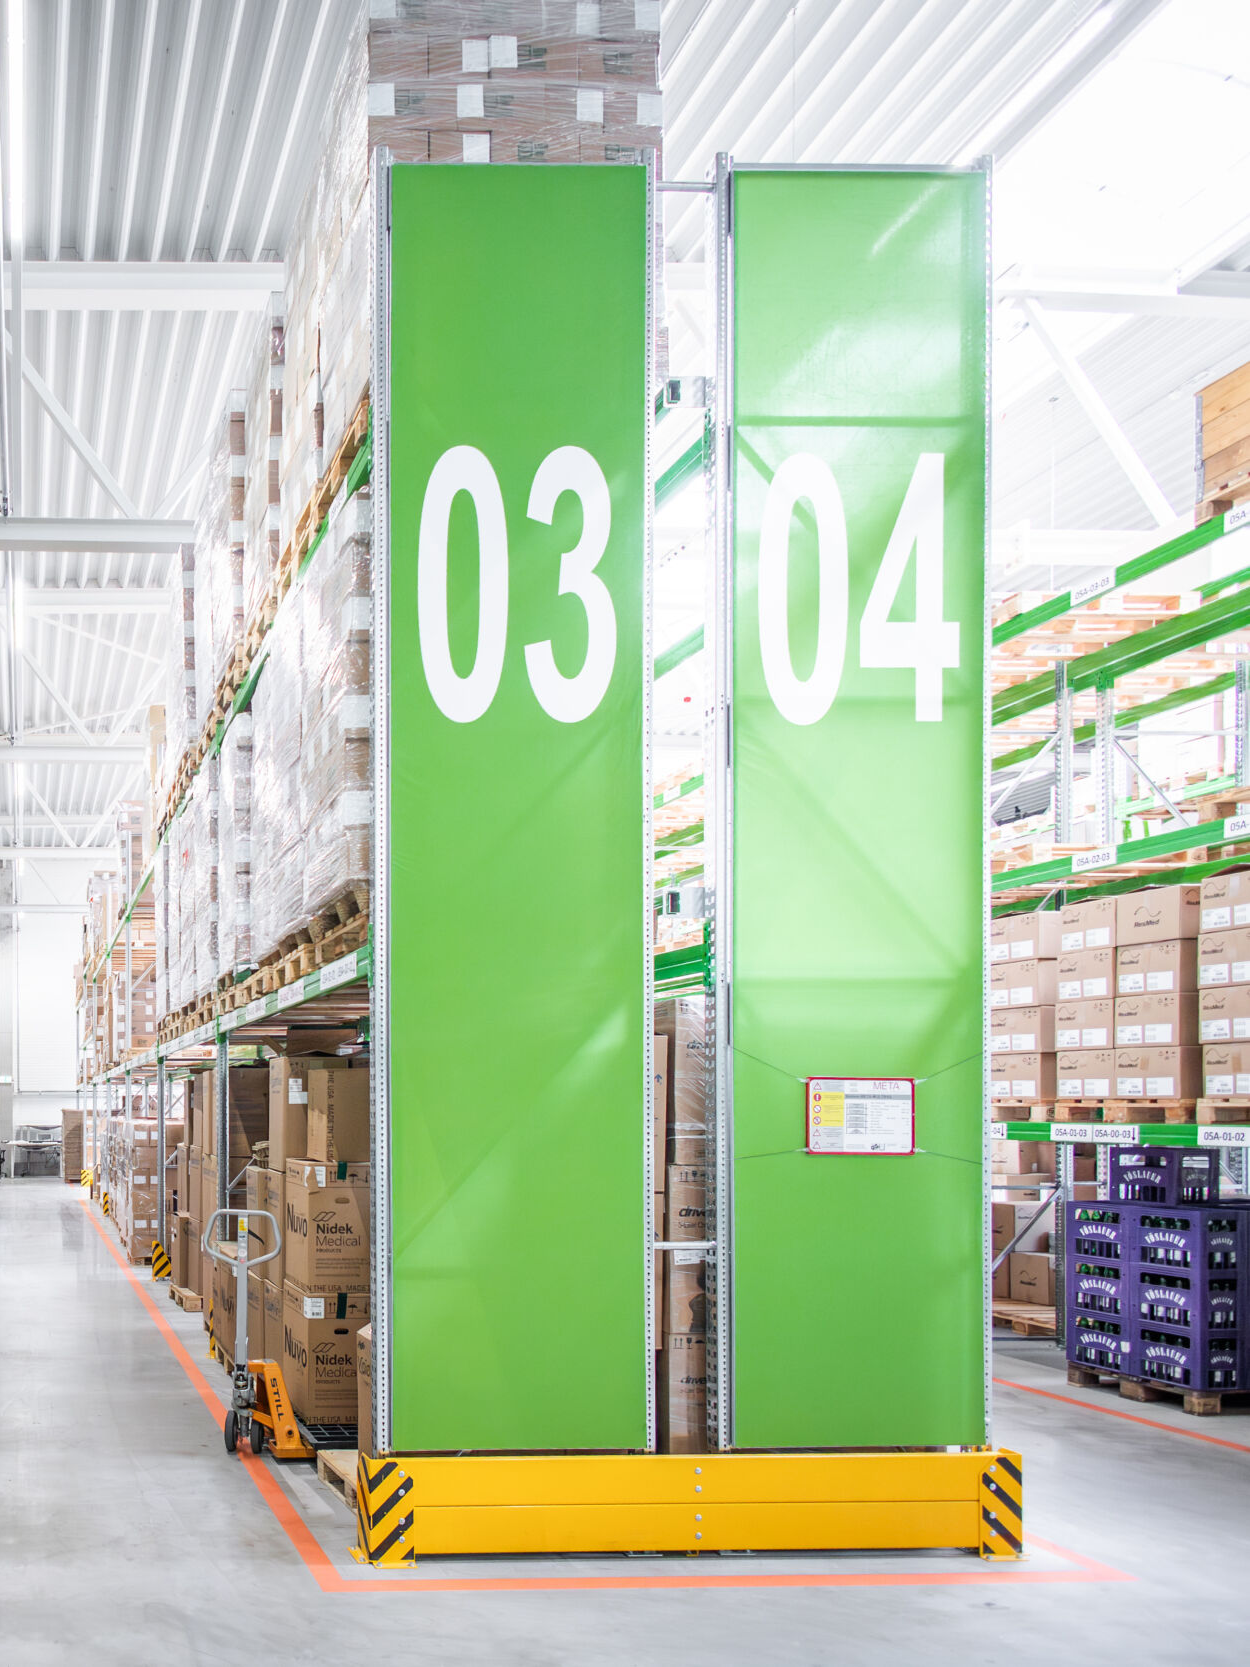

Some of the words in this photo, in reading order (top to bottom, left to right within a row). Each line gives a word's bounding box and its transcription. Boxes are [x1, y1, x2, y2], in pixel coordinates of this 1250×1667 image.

[418, 445, 617, 724] 03
[758, 452, 960, 726] 04
[1074, 576, 1111, 600] 05A-03-03
[1076, 852, 1112, 867] 05A-02-03
[872, 1081, 900, 1091] META
[1055, 1128, 1087, 1138] 05A-01-03
[1095, 1129, 1131, 1139] 05A-00-03
[1204, 1131, 1246, 1142] 05A-01-02
[1123, 1168, 1162, 1184] VÖSLAUER
[287, 1202, 308, 1238] Nuvo
[316, 1223, 353, 1235] Nidek
[1079, 1224, 1116, 1241] VÖSLAUER
[316, 1235, 361, 1246] Medical
[1144, 1232, 1186, 1248] VÖSLAUER
[314, 1284, 326, 1292] THE
[328, 1284, 342, 1292] USA
[1079, 1278, 1117, 1296] VÖSLAUER
[1144, 1289, 1186, 1307] VÖSLAUER
[284, 1324, 308, 1368] Nuvo
[1079, 1333, 1117, 1351] VÖSLAUER
[315, 1354, 353, 1366] Nidek
[1145, 1346, 1187, 1365] VÖSLAUER
[315, 1366, 357, 1378] Medica
[270, 1377, 284, 1422] STILL
[312, 1415, 326, 1423] THE
[327, 1415, 341, 1423] USA
